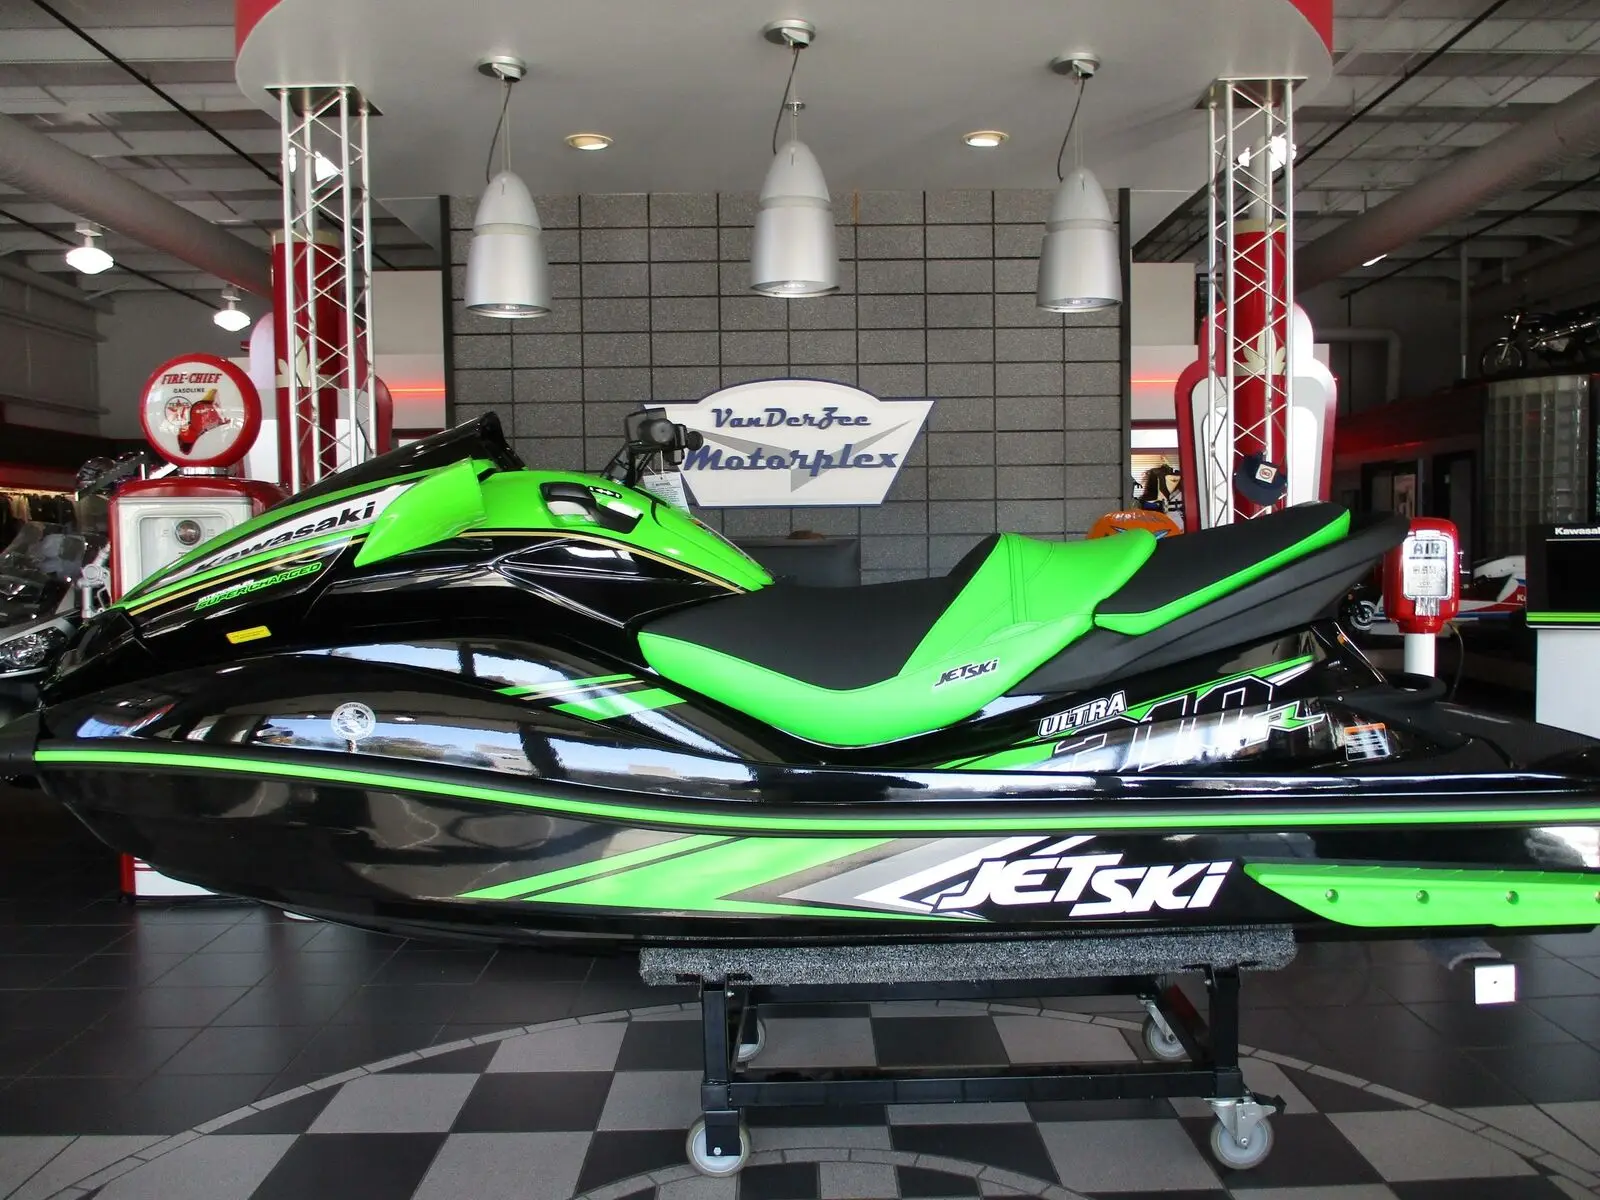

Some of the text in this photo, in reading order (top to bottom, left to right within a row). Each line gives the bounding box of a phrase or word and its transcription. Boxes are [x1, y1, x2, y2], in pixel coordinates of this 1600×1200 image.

[161, 373, 222, 384] FIRE-CHIEF
[711, 407, 872, 430] VanDerZee
[683, 444, 899, 477] Motorplex
[194, 501, 376, 573] Kawasaki
[1413, 543, 1441, 555] AIR
[1039, 691, 1127, 737] ULTRA
